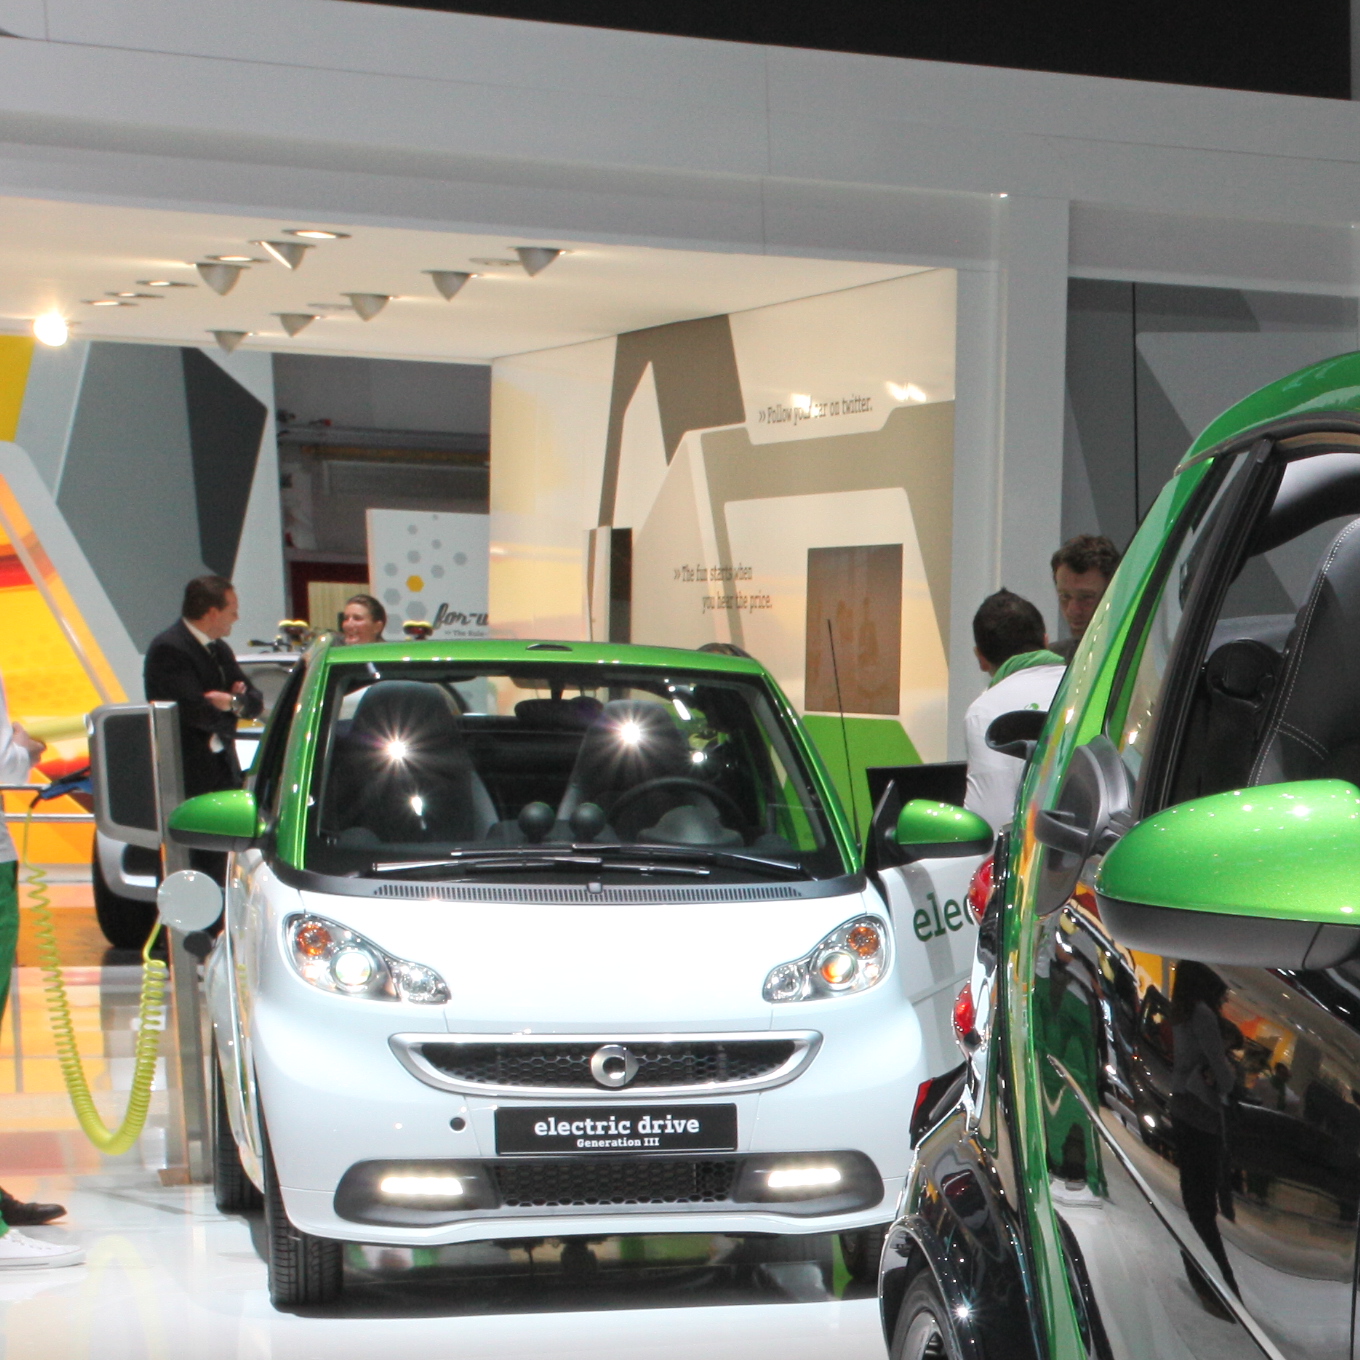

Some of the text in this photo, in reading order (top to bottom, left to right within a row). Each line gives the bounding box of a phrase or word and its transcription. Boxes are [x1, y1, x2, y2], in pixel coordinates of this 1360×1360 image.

[767, 404, 792, 424] Follow
[830, 400, 841, 416] on
[682, 563, 694, 582] The
[702, 596, 715, 614] you
[534, 1114, 700, 1136] electric drive
[577, 1137, 660, 1148] Generation III
